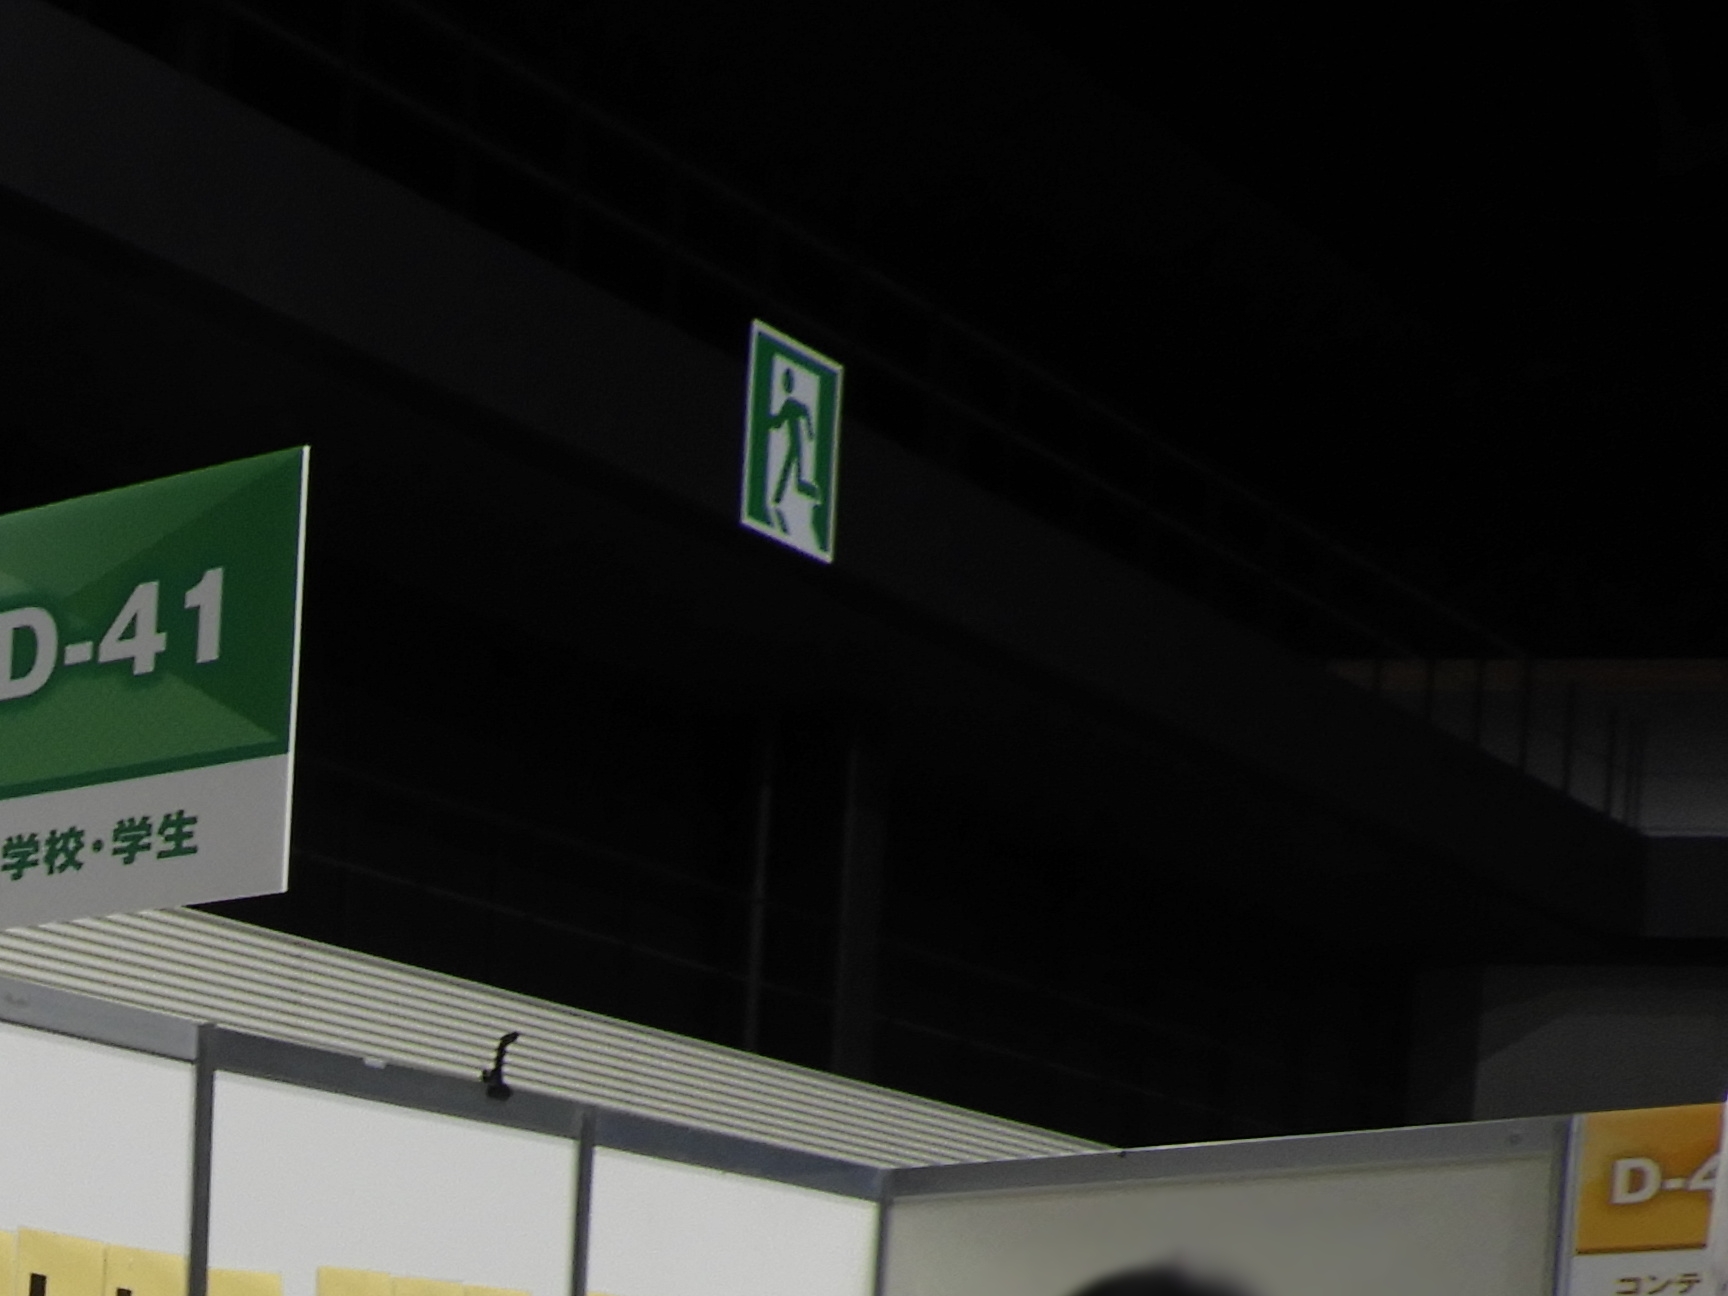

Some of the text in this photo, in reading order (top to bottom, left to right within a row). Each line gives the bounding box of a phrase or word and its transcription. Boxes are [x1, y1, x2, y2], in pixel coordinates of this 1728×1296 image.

[0, 808, 199, 882] 学校・学生
